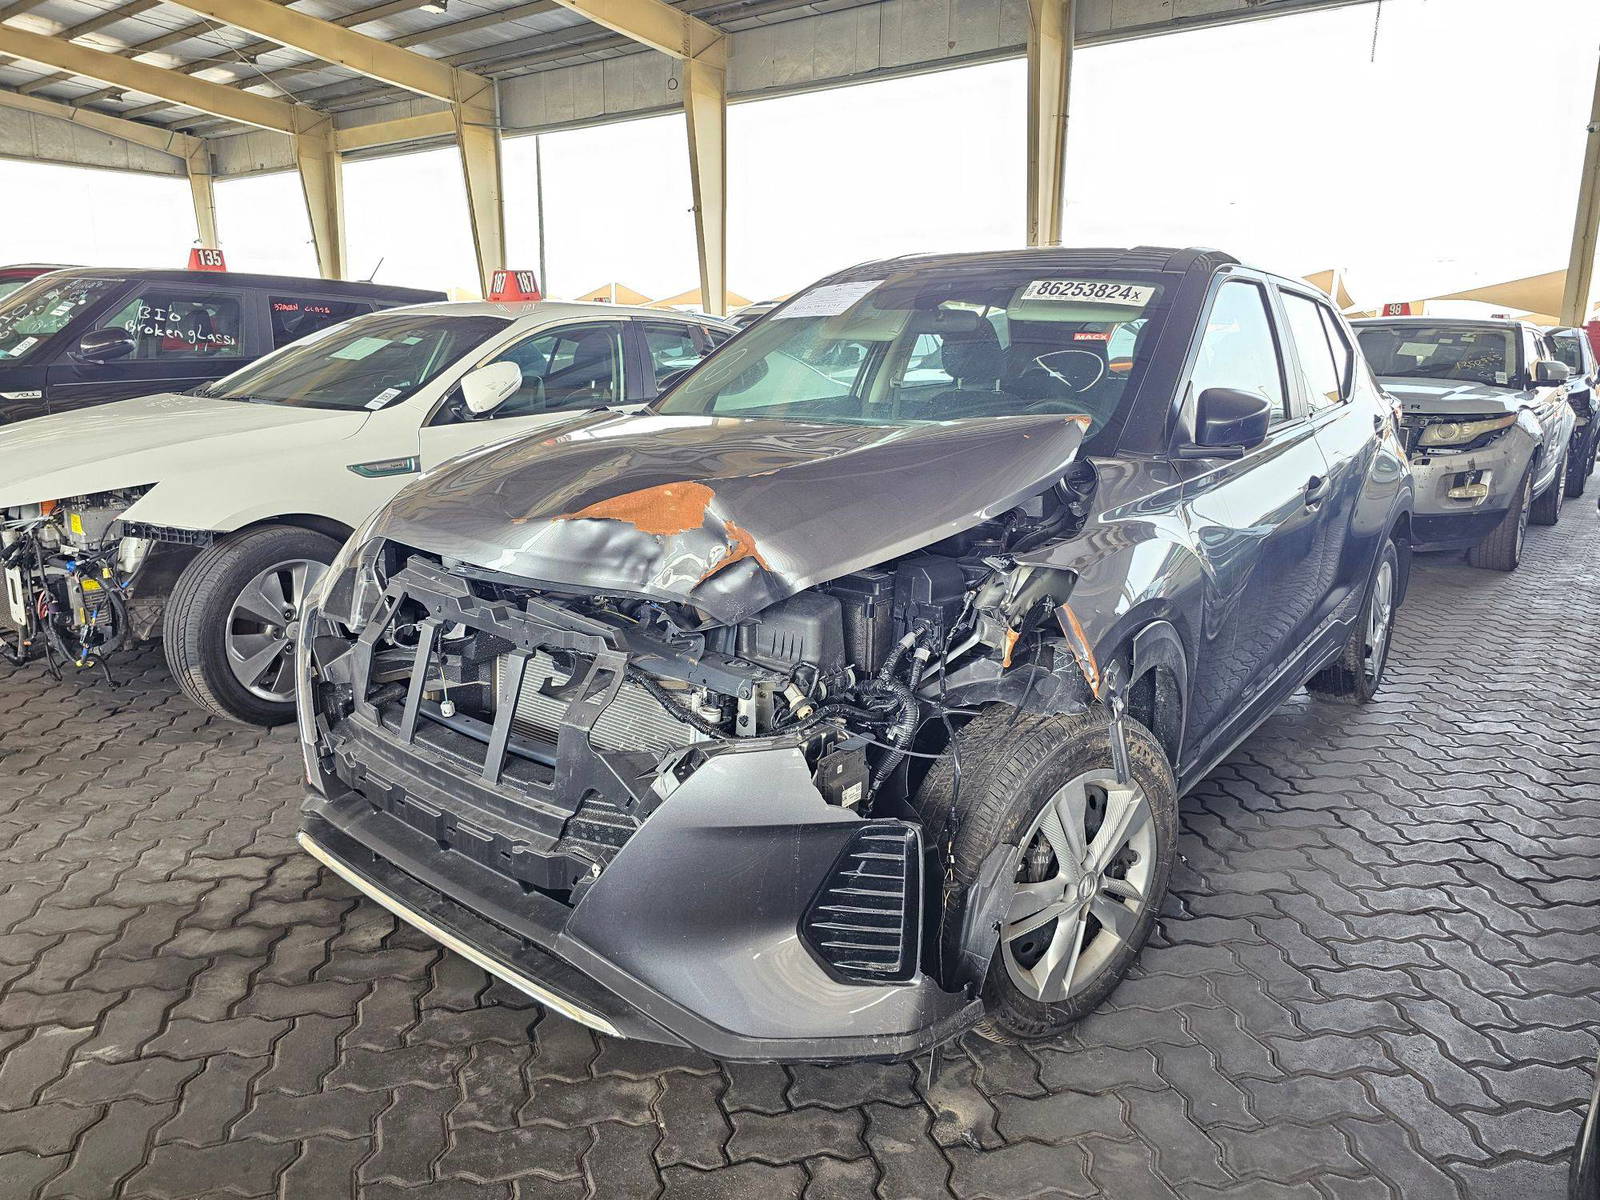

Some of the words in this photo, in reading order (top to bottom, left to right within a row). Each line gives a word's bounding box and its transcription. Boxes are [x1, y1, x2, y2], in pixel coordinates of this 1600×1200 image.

[198, 250, 222, 266] 135
[493, 272, 507, 294] 187
[517, 272, 536, 293] 187
[1389, 303, 1402, 315] 98
